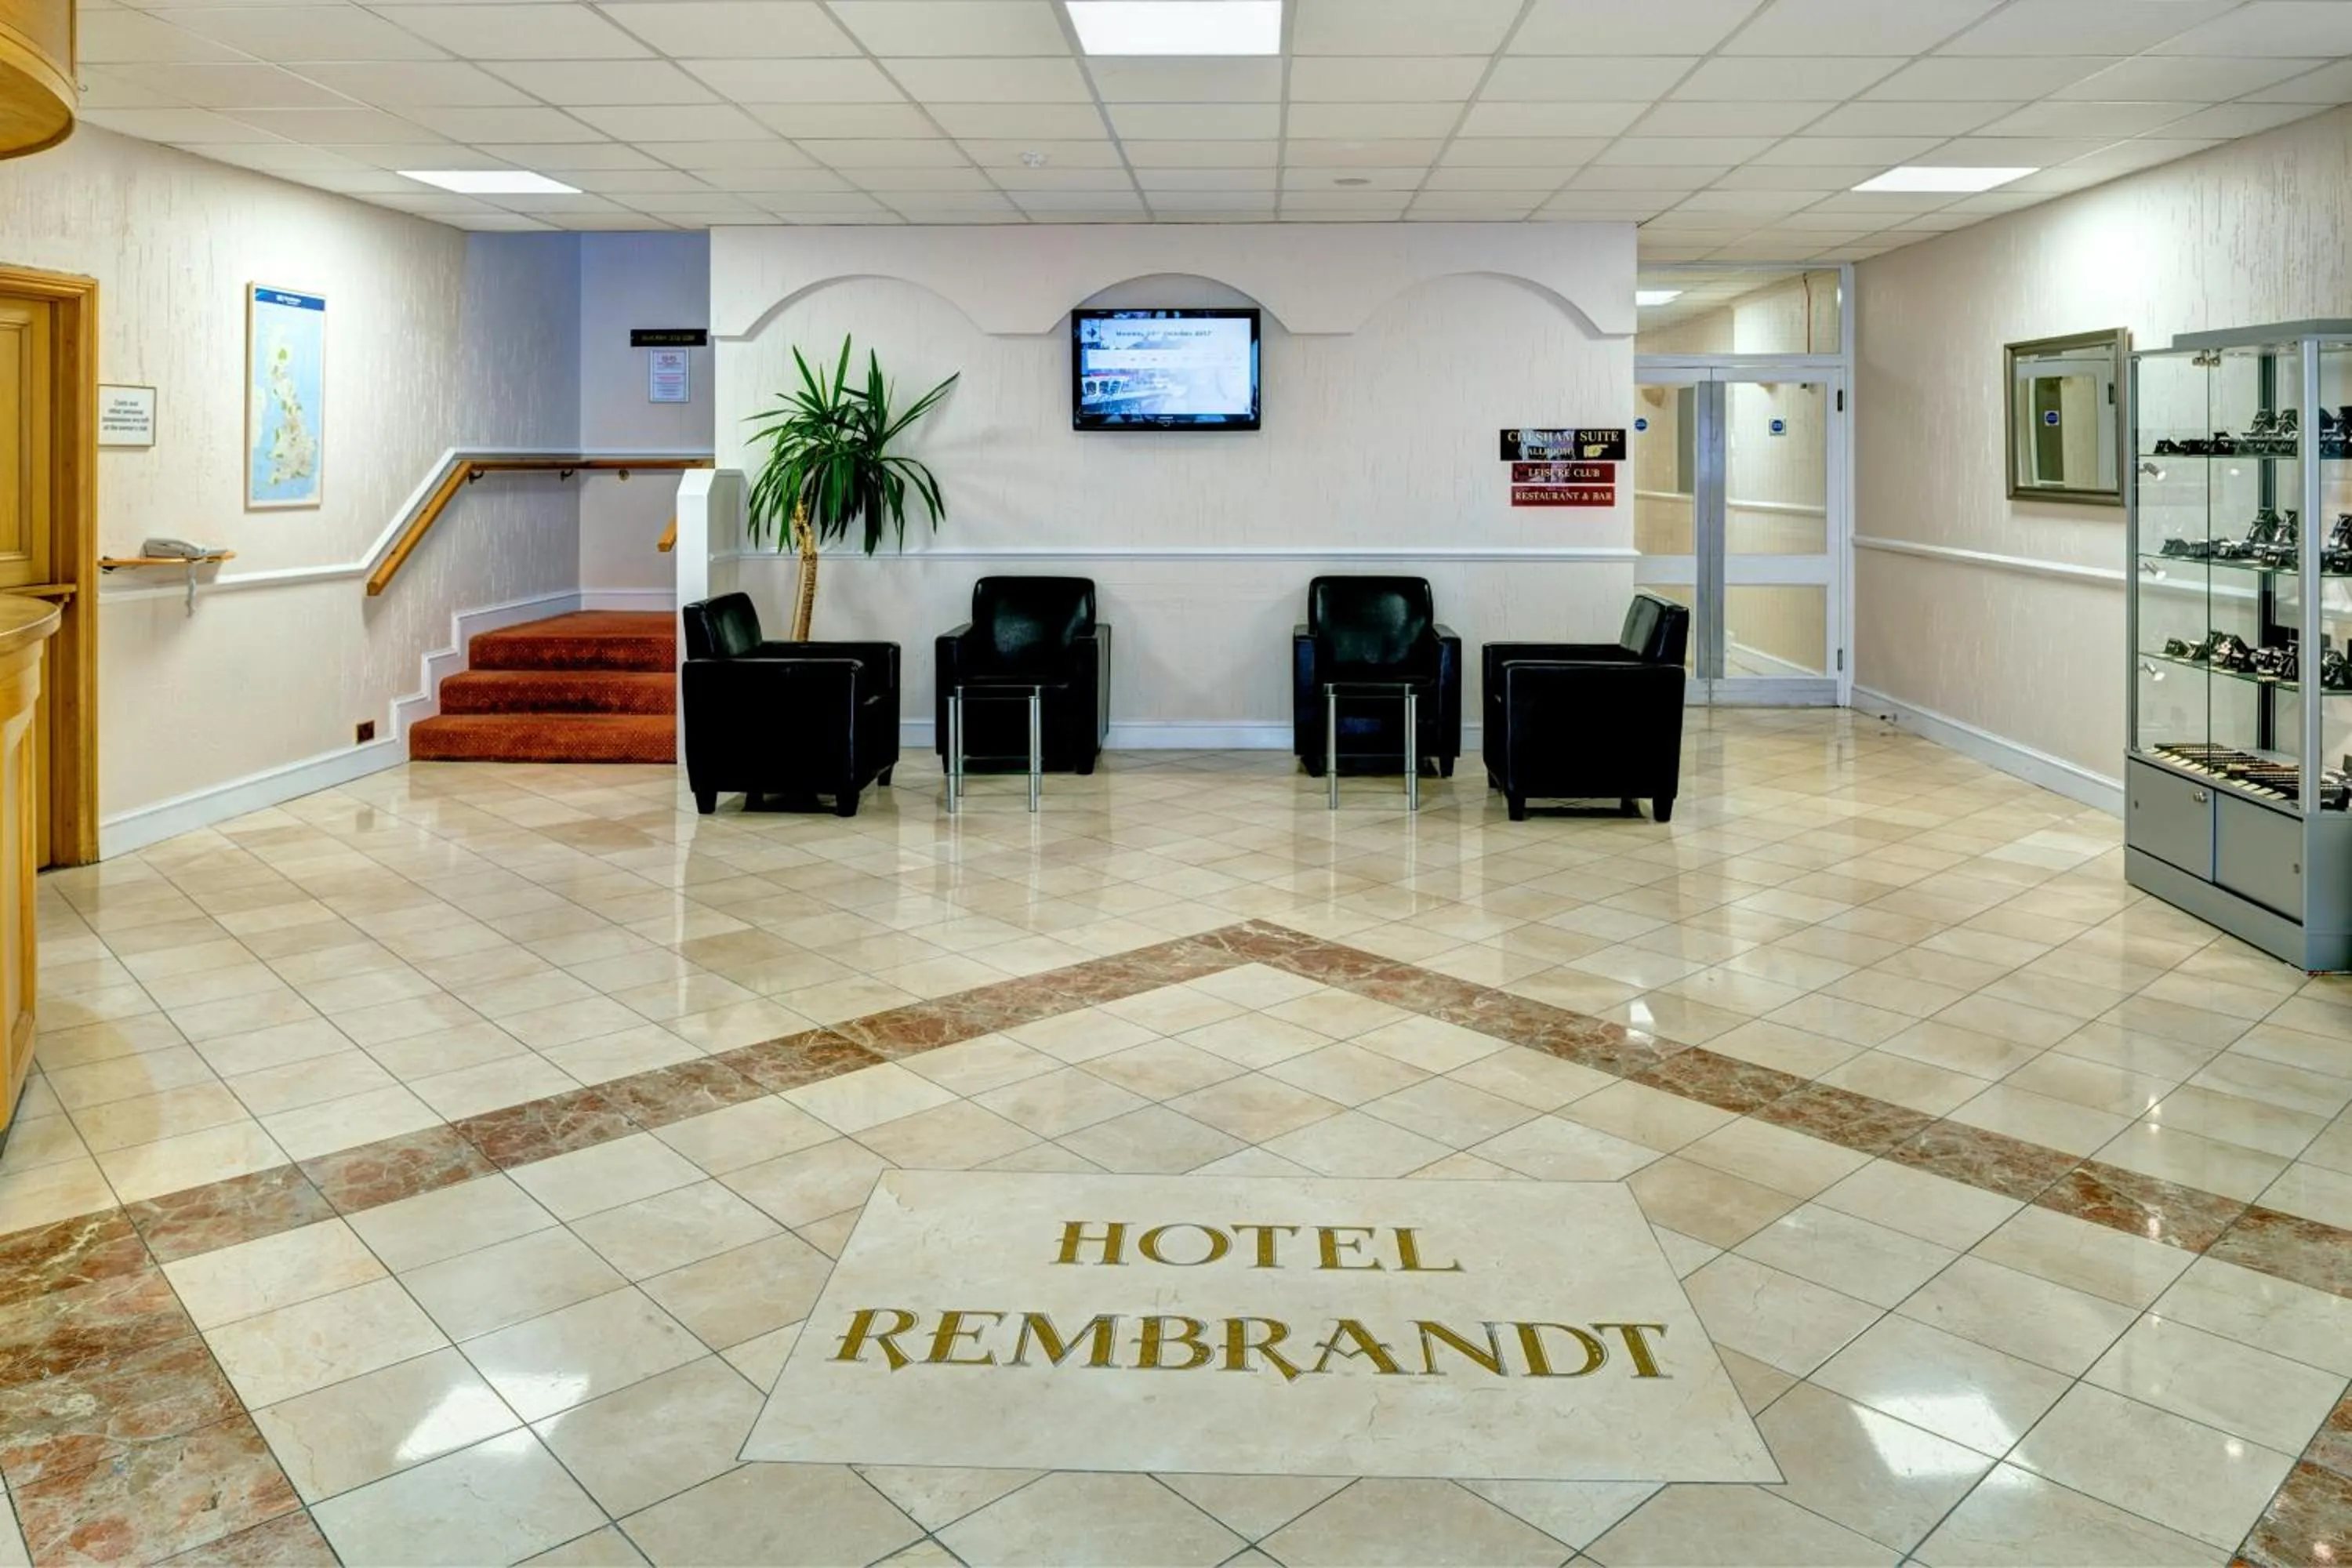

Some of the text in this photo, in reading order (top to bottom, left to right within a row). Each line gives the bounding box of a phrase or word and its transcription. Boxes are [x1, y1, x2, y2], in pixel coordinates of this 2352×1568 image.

[1580, 430, 1619, 442] SUITE
[1529, 468, 1600, 477] LEISRE CLUB
[1515, 492, 1579, 500] RESTAURANT
[1592, 492, 1613, 500] BAR
[1048, 1221, 1466, 1272] HOTEL
[825, 1308, 1674, 1384] REMBRANDT
